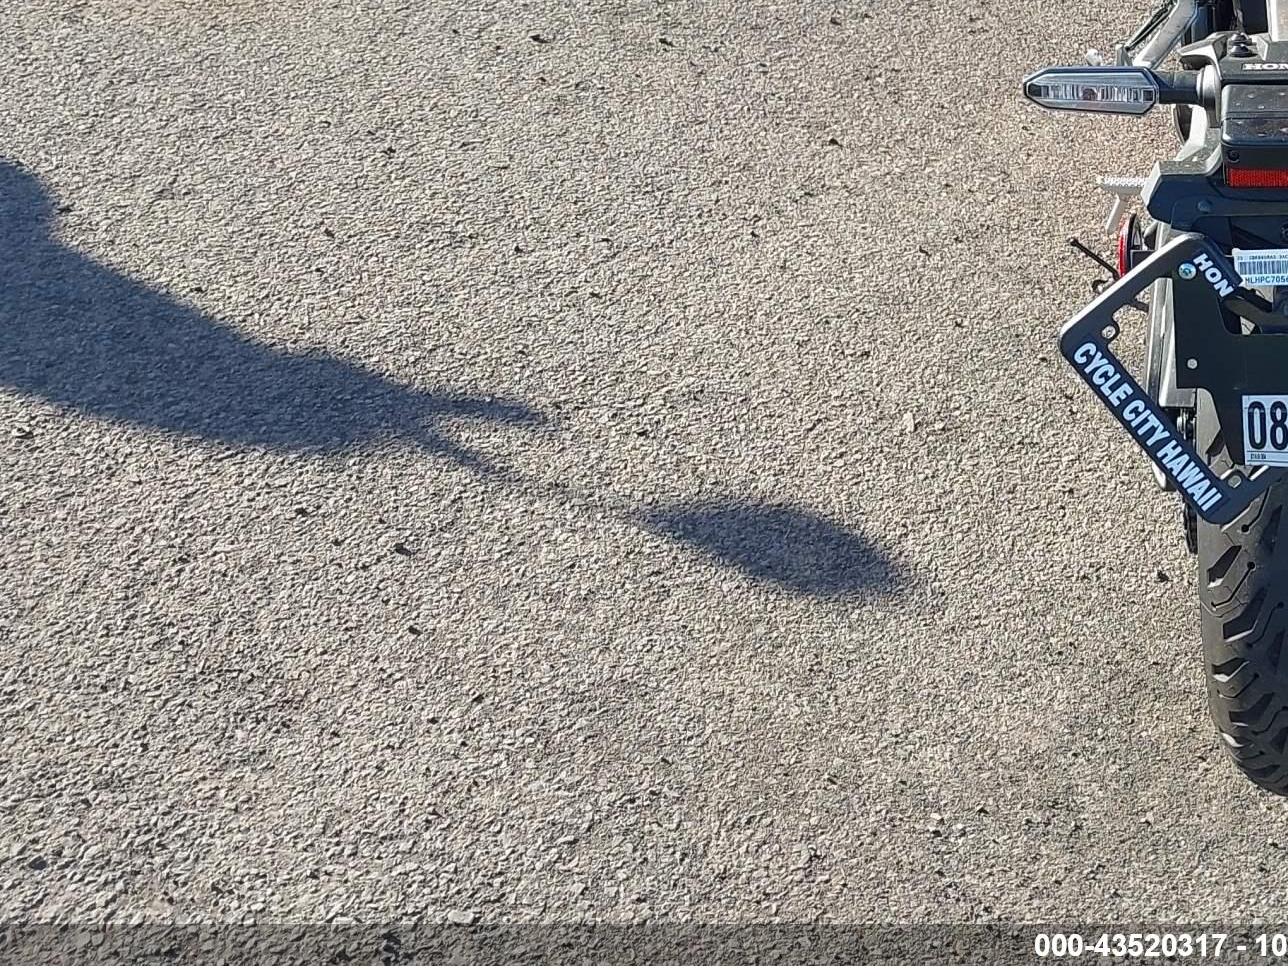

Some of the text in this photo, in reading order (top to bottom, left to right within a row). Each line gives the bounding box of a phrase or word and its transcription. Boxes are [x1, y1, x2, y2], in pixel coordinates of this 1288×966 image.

[1193, 253, 1235, 298] HON
[1073, 342, 1224, 512] CYCLE CITY HAWAII
